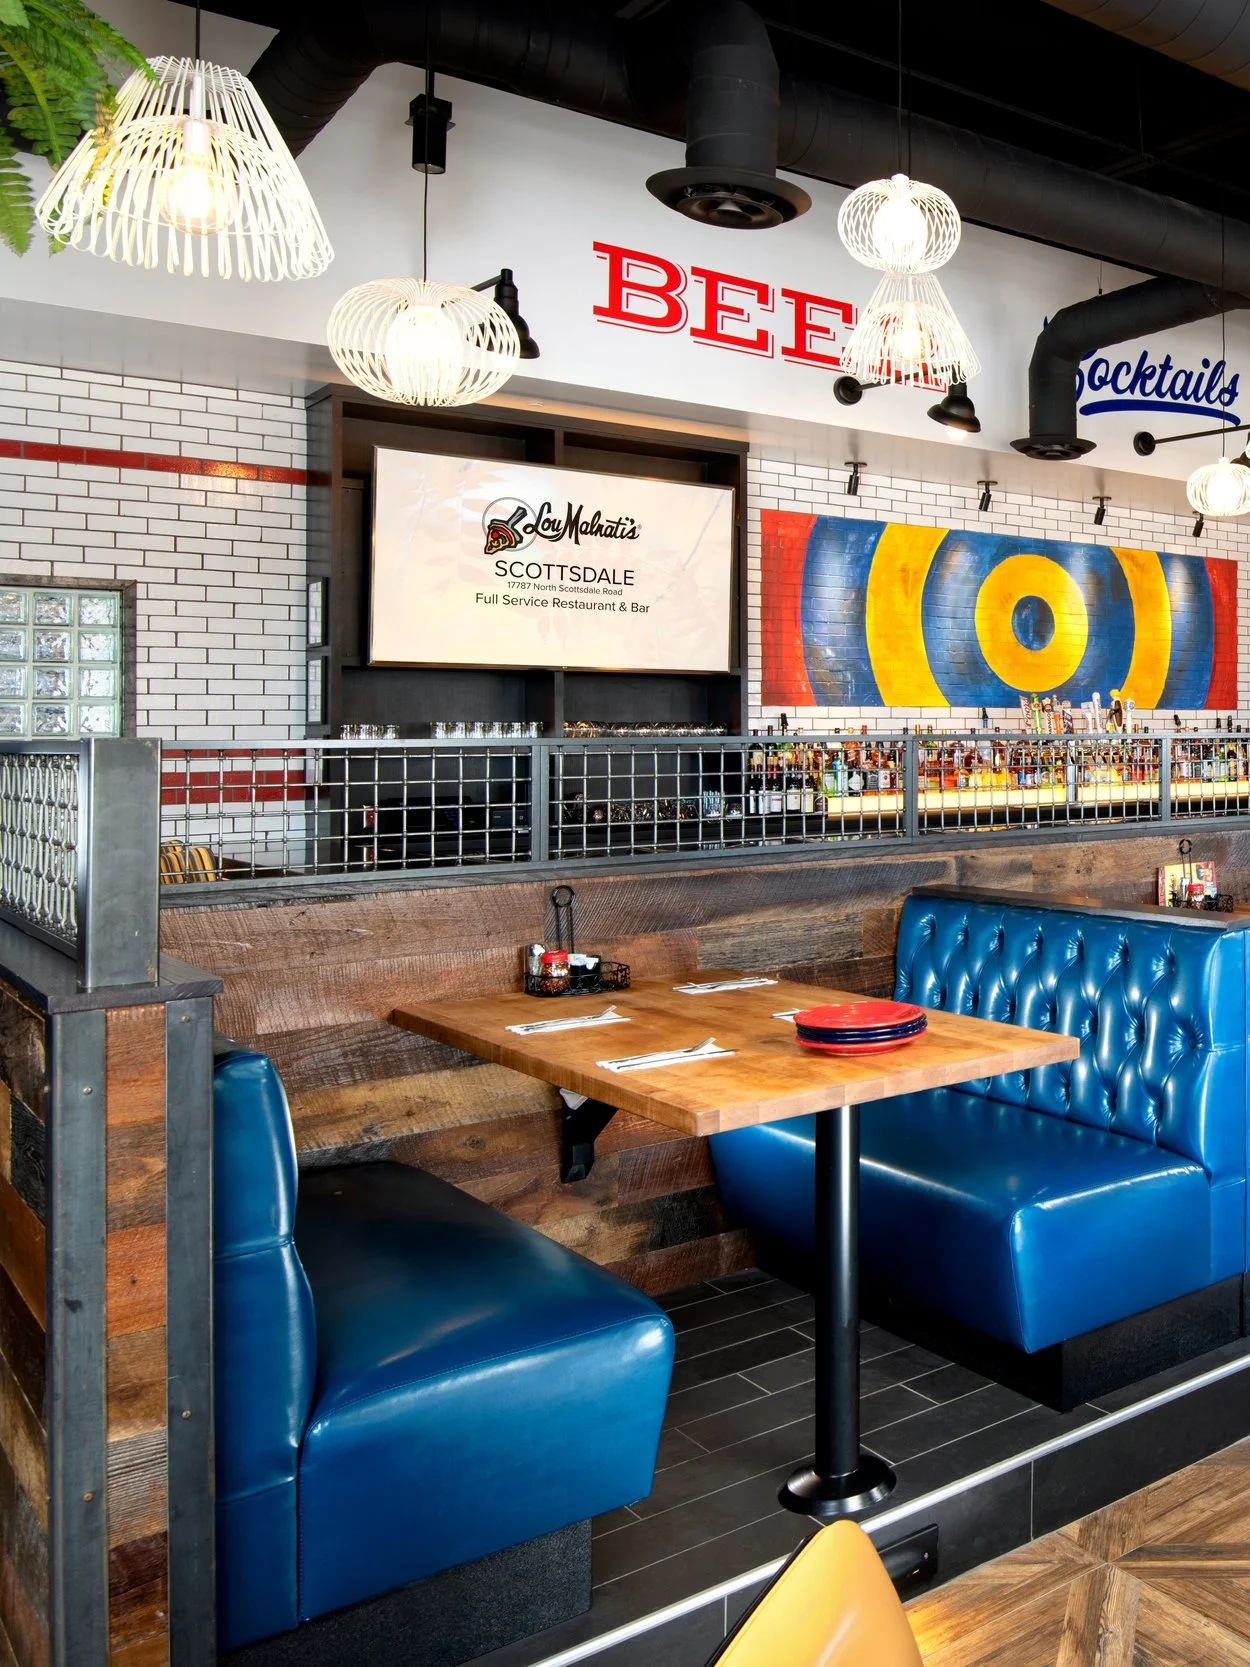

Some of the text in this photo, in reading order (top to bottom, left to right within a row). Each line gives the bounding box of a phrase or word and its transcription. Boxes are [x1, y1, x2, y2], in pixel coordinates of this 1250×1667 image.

[522, 501, 641, 545] Lou Malnati's
[494, 560, 635, 586] SCOTTSDALE
[507, 580, 623, 596] 17787 North Scottsdale Road
[475, 592, 650, 613] Full Service Restaurant & Bar
